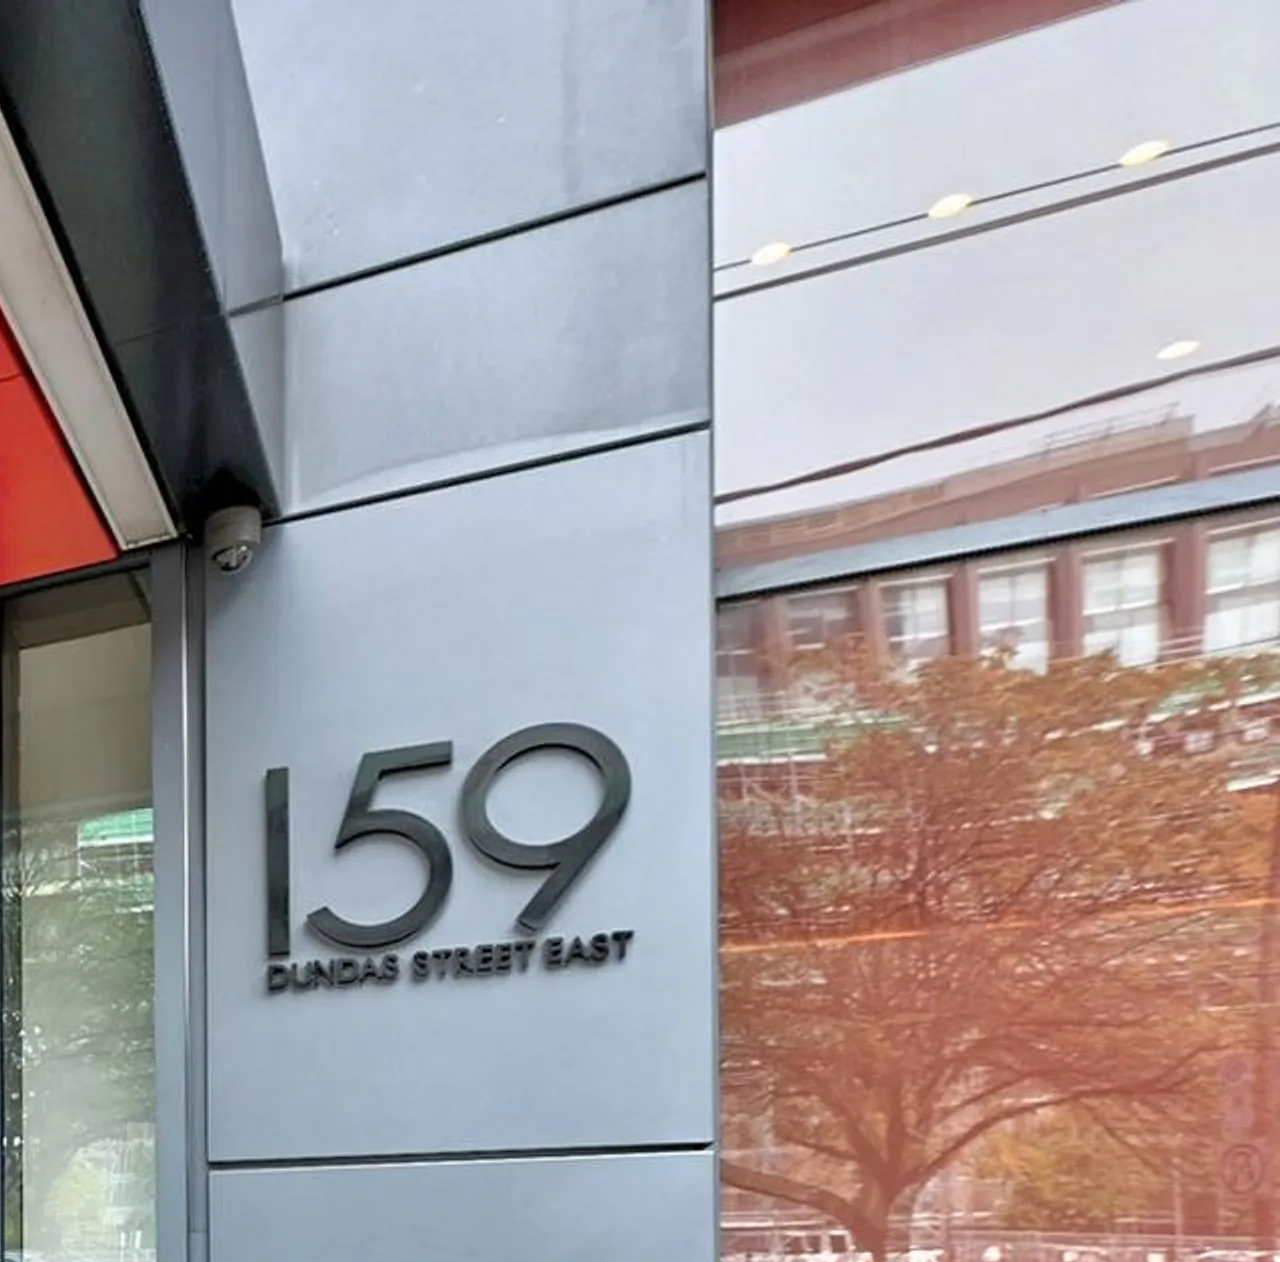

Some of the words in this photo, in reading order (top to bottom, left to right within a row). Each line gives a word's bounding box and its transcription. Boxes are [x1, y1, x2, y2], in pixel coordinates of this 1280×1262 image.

[265, 722, 633, 957] 159
[266, 952, 400, 994] DUNDAS
[410, 938, 537, 980] STREET
[542, 929, 635, 967] EAST
